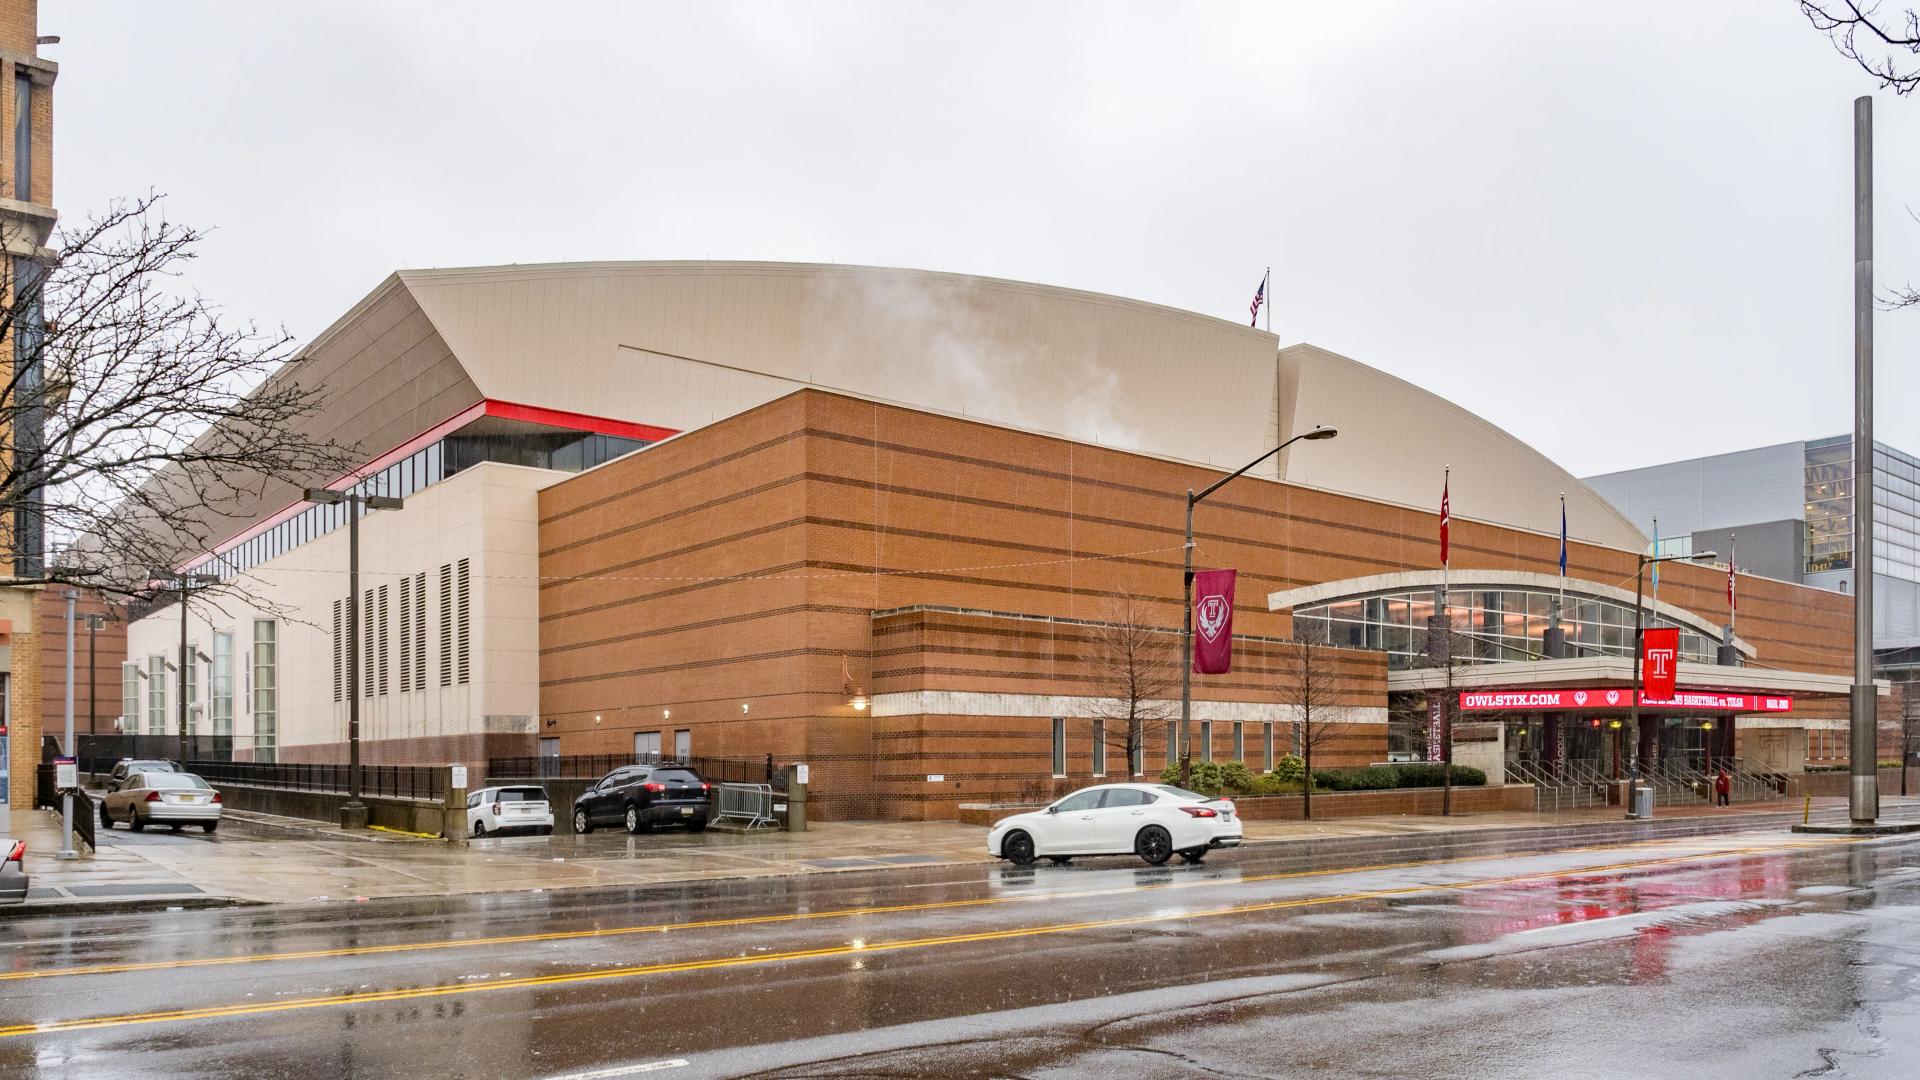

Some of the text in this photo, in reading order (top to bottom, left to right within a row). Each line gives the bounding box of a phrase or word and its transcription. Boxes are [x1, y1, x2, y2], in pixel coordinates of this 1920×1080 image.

[1648, 648, 1673, 678] T
[1466, 694, 1560, 706] OWLSTIX.COM
[1684, 695, 1718, 706] BASKETBALL
[1727, 697, 1743, 707] TULSA
